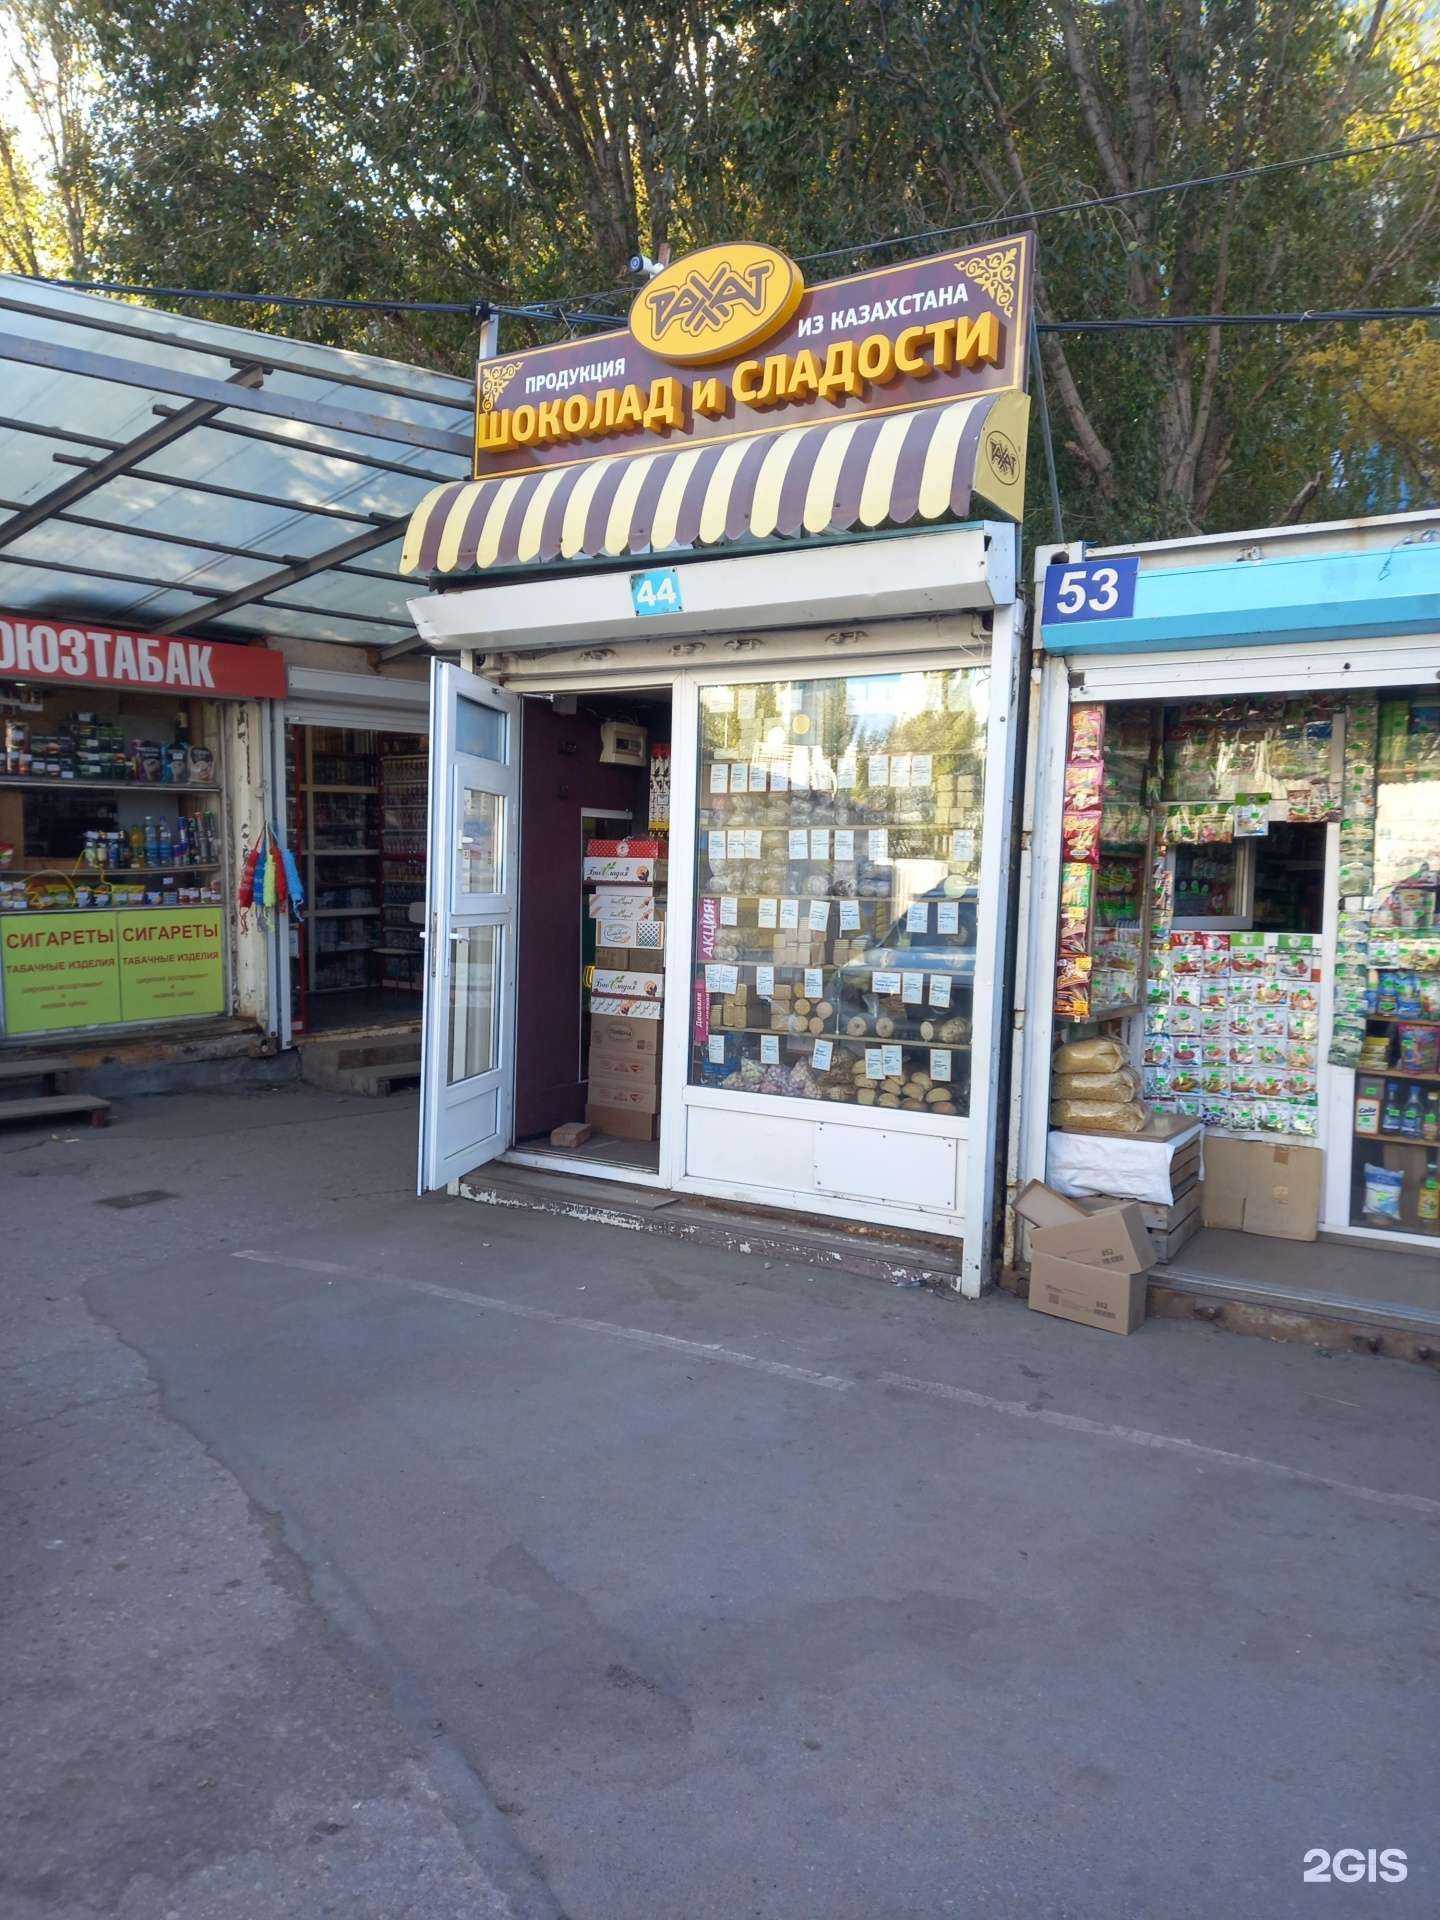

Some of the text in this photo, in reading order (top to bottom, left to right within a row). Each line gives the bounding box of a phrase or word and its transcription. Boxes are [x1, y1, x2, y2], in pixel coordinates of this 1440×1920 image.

[525, 283, 969, 394] ПРОДУКЦИЯ ИЗ КАЗАХСТАНА
[478, 376, 680, 450] ШОКОЛАД
[731, 311, 996, 403] СЛАДОСТИ
[637, 577, 677, 607] 44
[1056, 567, 1119, 614] 53
[6, 928, 115, 950] СИГАРЕТЫ
[122, 924, 219, 943] СИГАРЕТЫ
[702, 898, 717, 959] АКЦИЯ!
[5, 957, 116, 974] ТАБАЧНЫЕ ИЗДЕЛИЯ
[122, 951, 219, 966] ТАБАЧНЫЕ ИЗДЕЛИЯ
